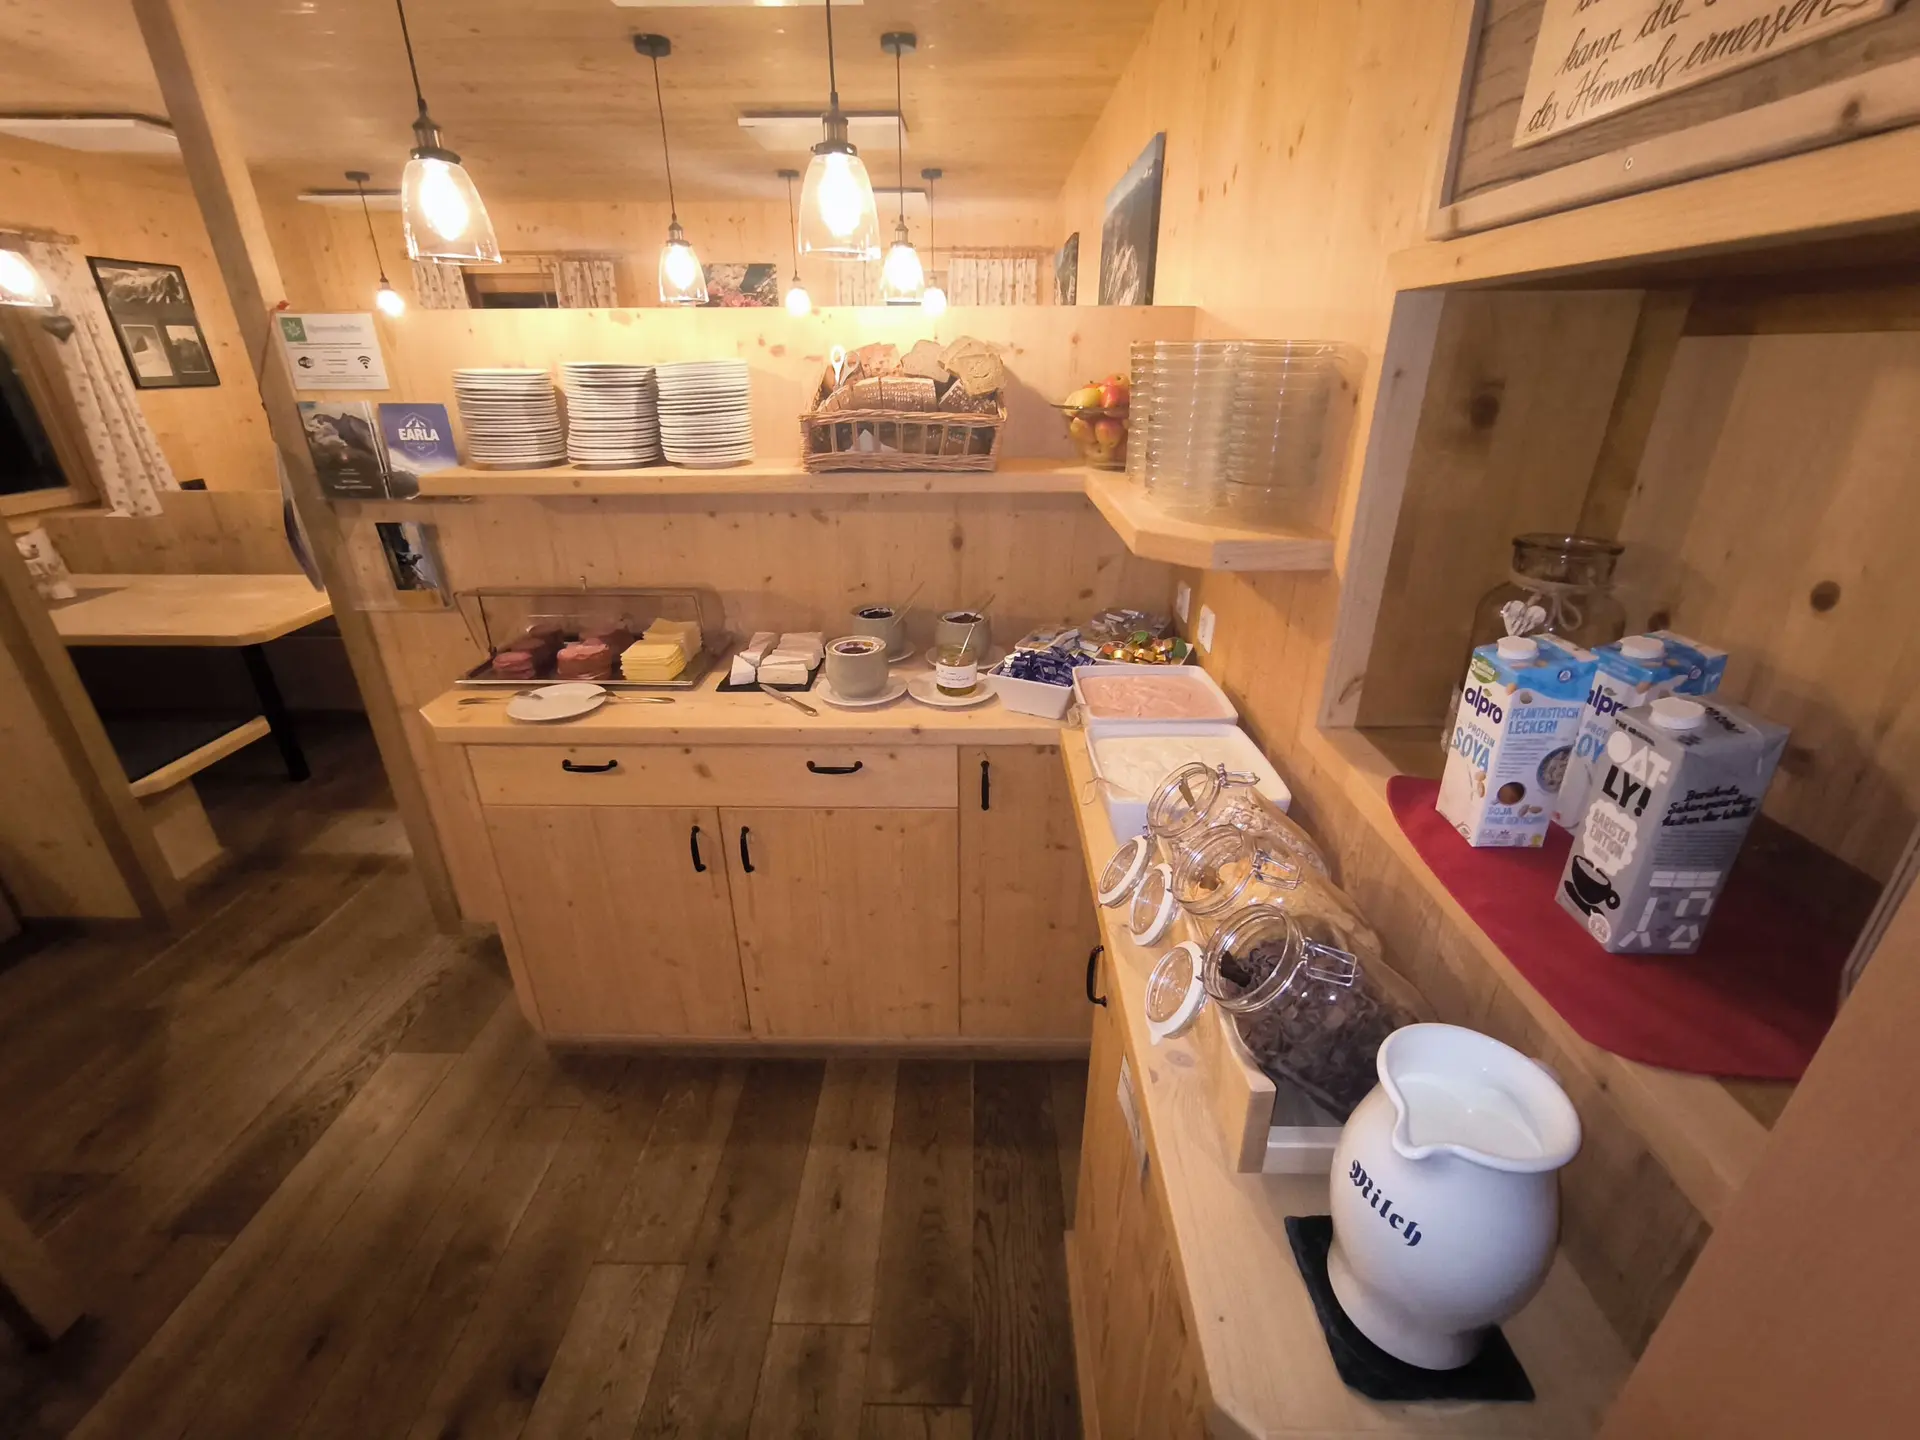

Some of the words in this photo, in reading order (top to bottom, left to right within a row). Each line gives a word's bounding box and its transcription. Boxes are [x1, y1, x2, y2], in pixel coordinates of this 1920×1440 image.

[1555, 28, 1625, 76] kann
[1524, 90, 1559, 132] des
[1566, 33, 1683, 120] Himmels
[398, 428, 440, 441] EARLA
[1464, 685, 1503, 724] alpro
[1510, 706, 1580, 720] PFLANTASTISCH
[1467, 722, 1495, 748] PROTEIN
[1507, 719, 1558, 735] LECKER!
[1451, 727, 1490, 773] SOYA
[1602, 765, 1652, 817] LY!
[1590, 823, 1625, 860] EDITION
[1592, 807, 1631, 846] BARISTA
[1348, 1159, 1422, 1247] Milch
